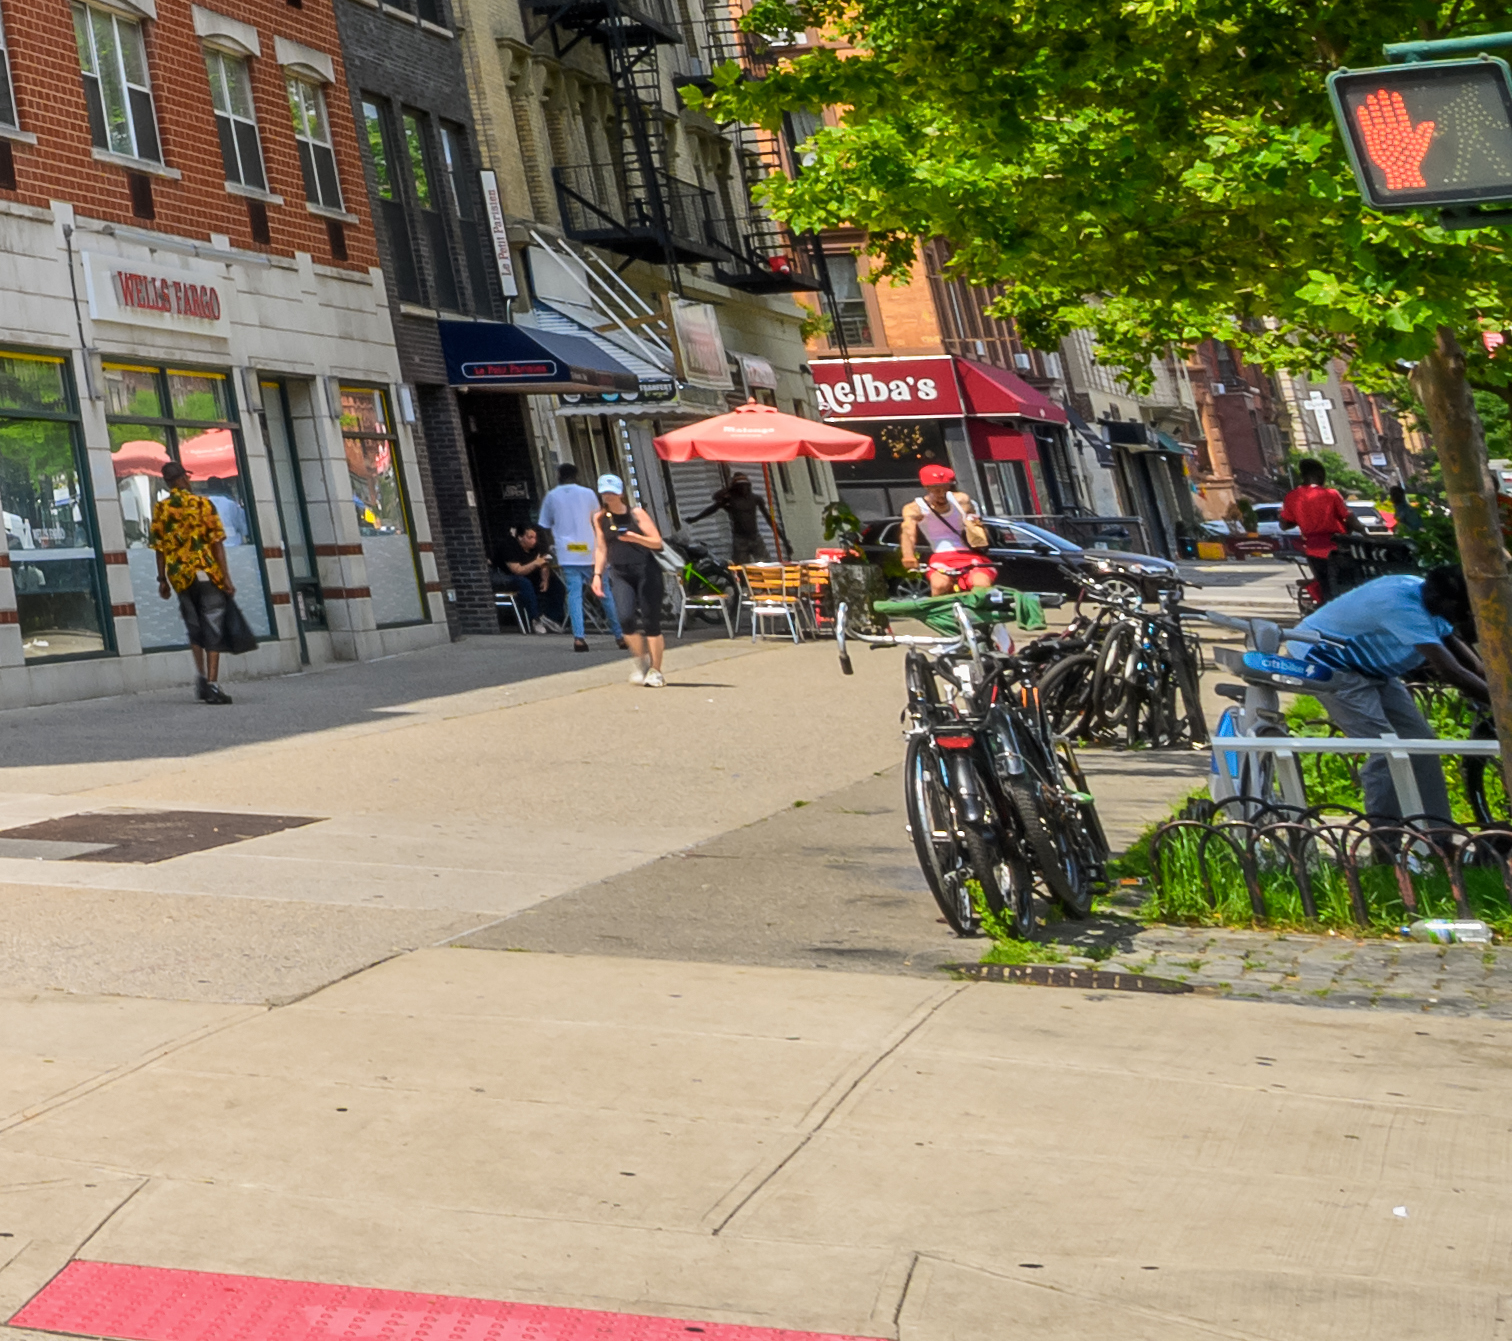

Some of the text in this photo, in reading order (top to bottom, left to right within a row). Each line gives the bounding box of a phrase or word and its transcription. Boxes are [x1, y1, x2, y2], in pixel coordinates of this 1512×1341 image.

[487, 189, 506, 235] Parisien
[497, 240, 511, 266] Petit
[115, 270, 221, 321] WELLS FARGO
